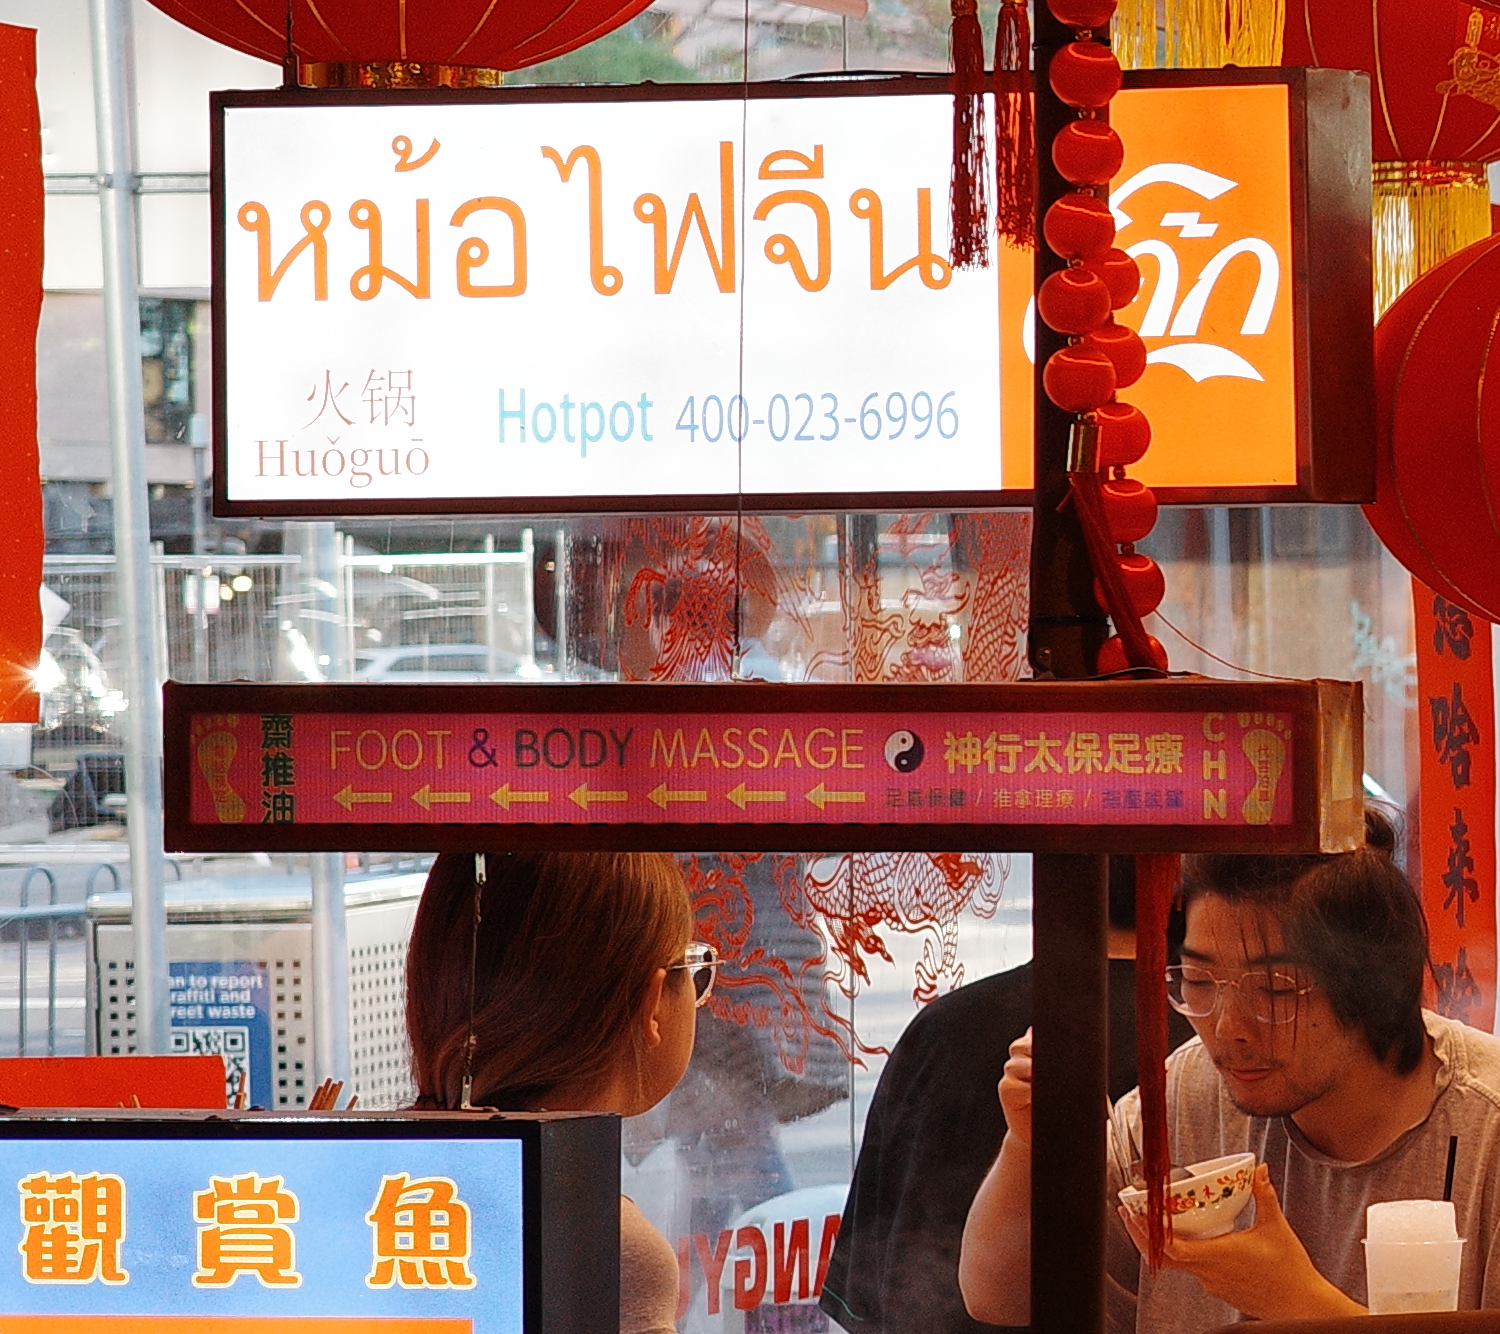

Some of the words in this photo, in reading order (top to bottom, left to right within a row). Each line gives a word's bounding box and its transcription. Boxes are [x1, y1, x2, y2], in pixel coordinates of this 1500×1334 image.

[237, 135, 953, 304] หม้อไฟจีน
[304, 367, 420, 430] 火锅
[496, 386, 656, 461] Hotpot
[674, 388, 961, 448] 400-023-6996
[254, 433, 431, 493] Huǒguō
[330, 729, 452, 770] FOOT
[467, 727, 499, 768] &
[514, 727, 635, 769] BODY
[649, 727, 865, 770] MASSAGE
[942, 730, 1185, 775] 神行太保足療
[171, 988, 216, 1003] raffiti
[220, 989, 251, 1003] and
[211, 974, 263, 993] report
[171, 1006, 205, 1019] reet
[207, 1006, 256, 1019] waste
[18, 1169, 479, 1290] 觀賞魚
